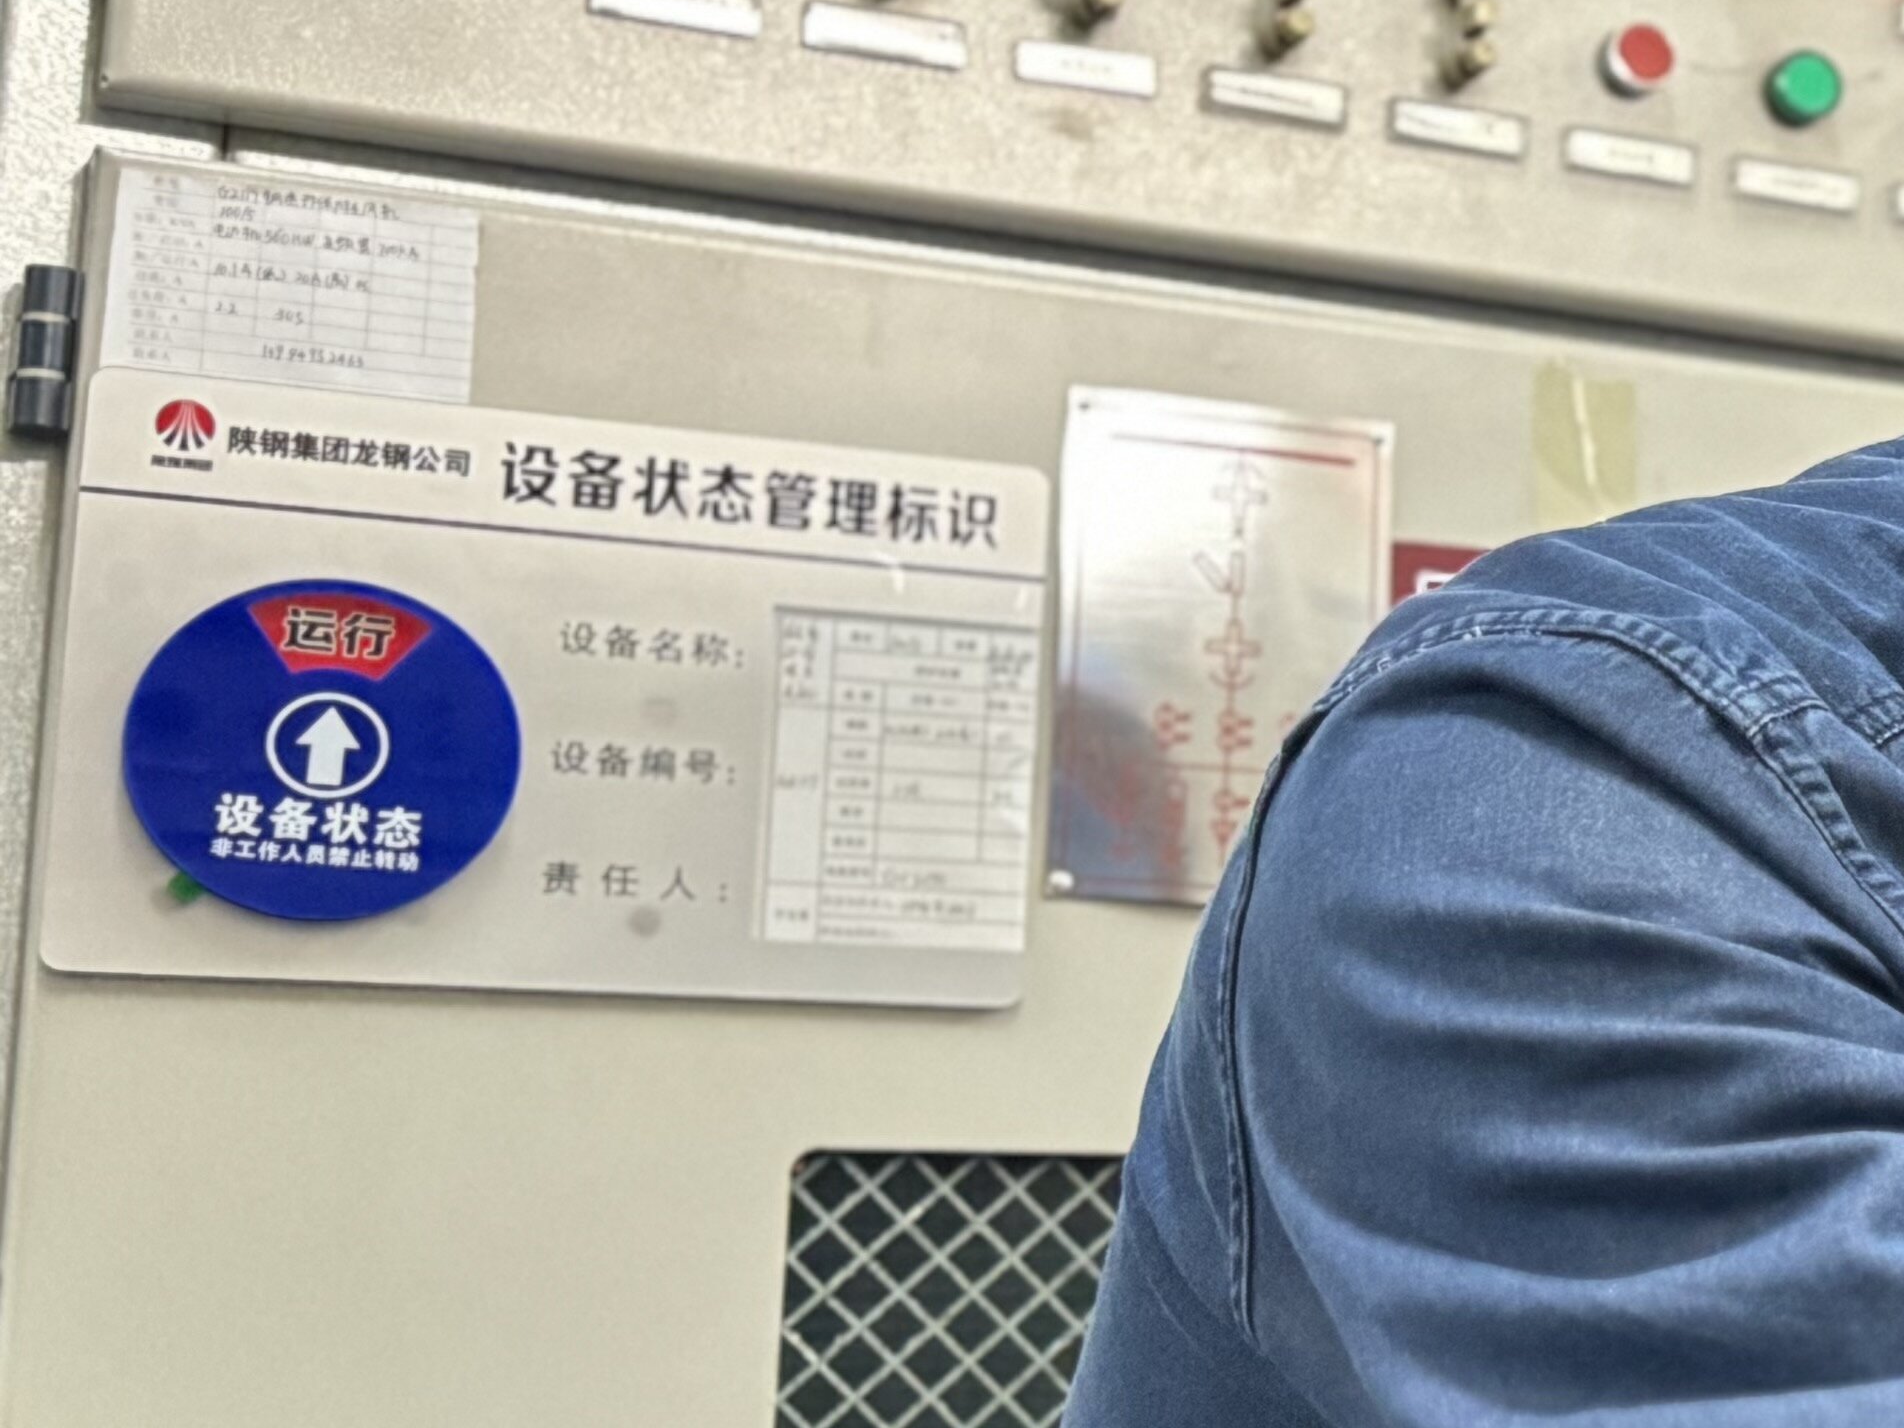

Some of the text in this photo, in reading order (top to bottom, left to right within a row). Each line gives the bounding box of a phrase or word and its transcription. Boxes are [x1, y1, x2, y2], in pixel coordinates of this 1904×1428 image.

[227, 425, 472, 478] 陕钢集团龙钢公司
[499, 441, 998, 550] 设备状态管理标识
[283, 606, 395, 658] 运行
[214, 792, 423, 849] 设备状态
[210, 837, 421, 873] 非工作人员禁止转动
